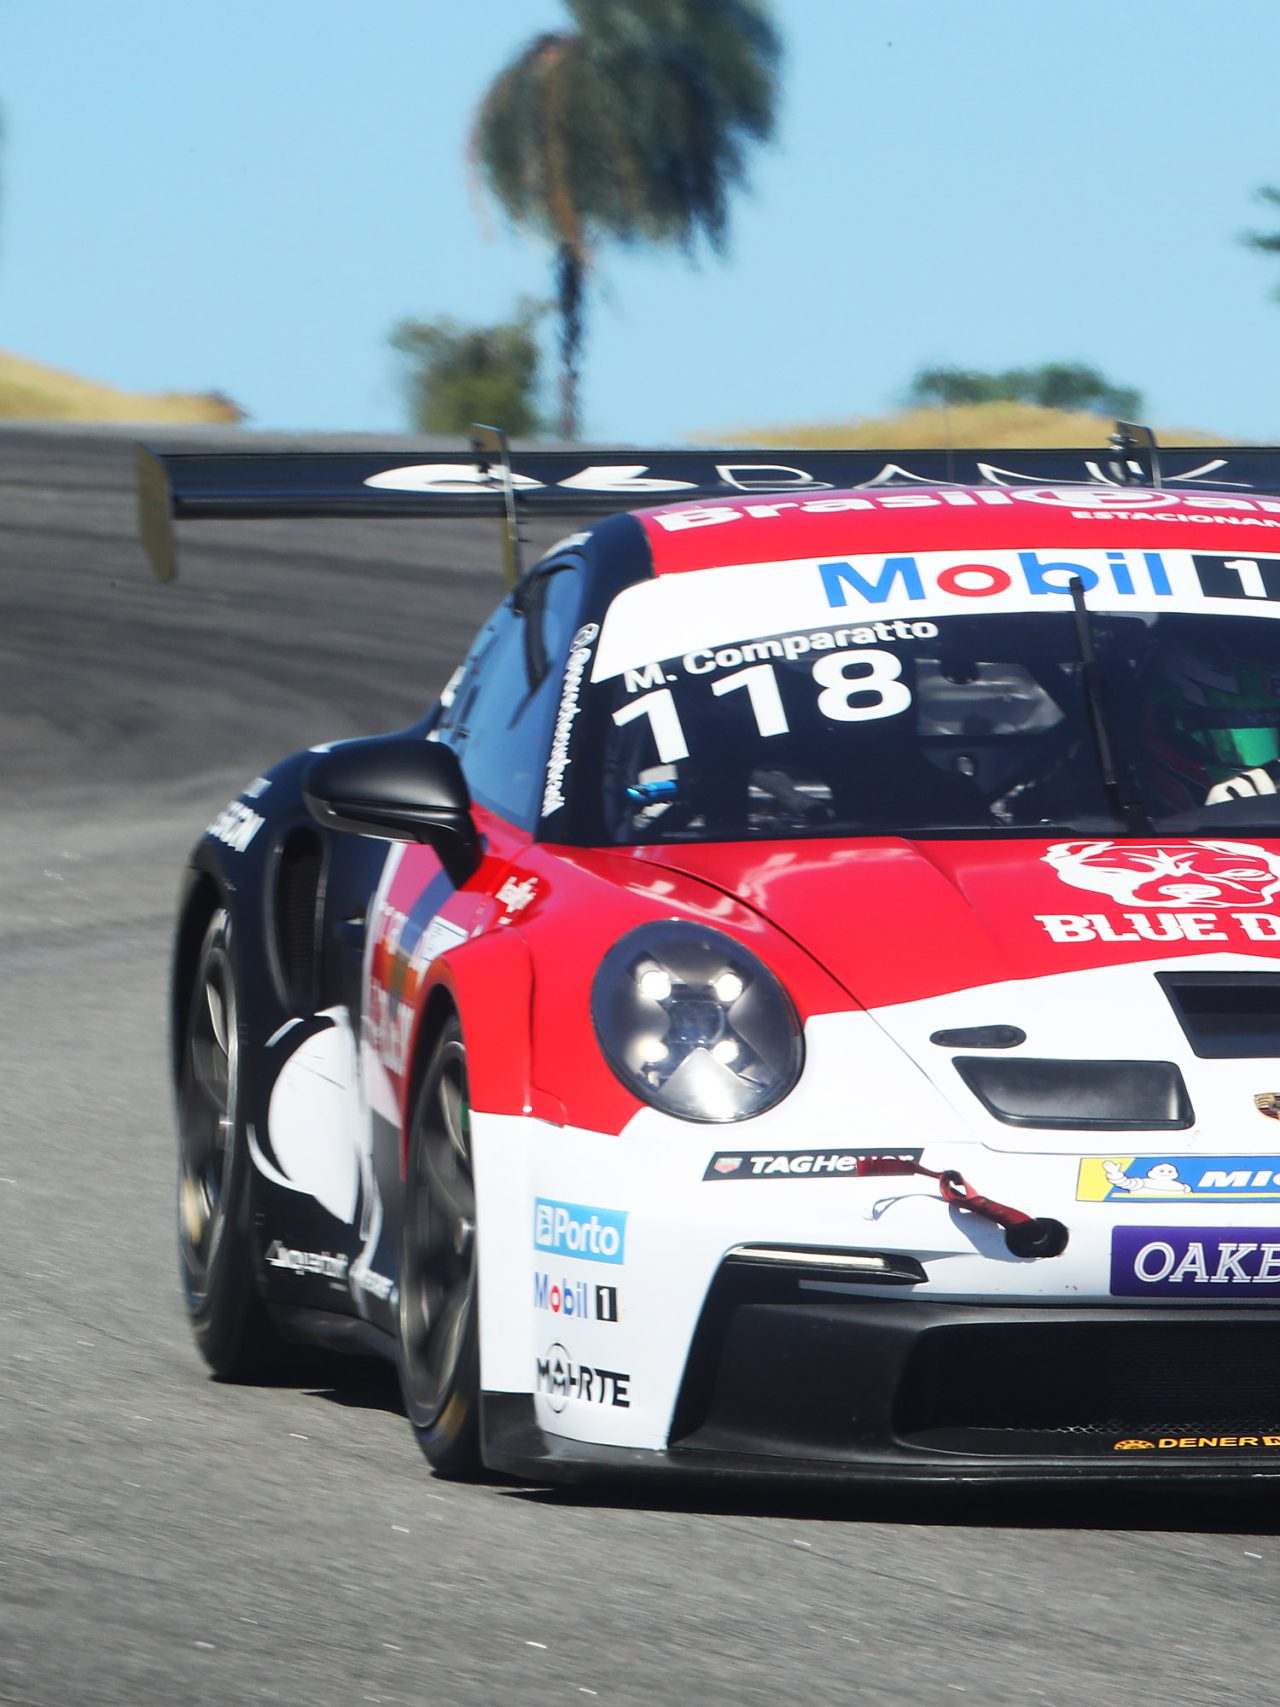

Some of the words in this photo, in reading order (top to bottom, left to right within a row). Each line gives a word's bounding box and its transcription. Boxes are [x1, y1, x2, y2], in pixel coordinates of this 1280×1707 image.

[817, 552, 1173, 608] Mobil
[1223, 559, 1268, 599] 1
[623, 662, 678, 694] M.
[683, 619, 939, 676] Comparatto
[611, 648, 912, 764] 118
[1034, 913, 1229, 943] BLUE
[554, 1207, 620, 1256] Porto
[534, 1271, 588, 1320] Mobil
[599, 1288, 612, 1320] 1
[1158, 1436, 1260, 1449] DENER
